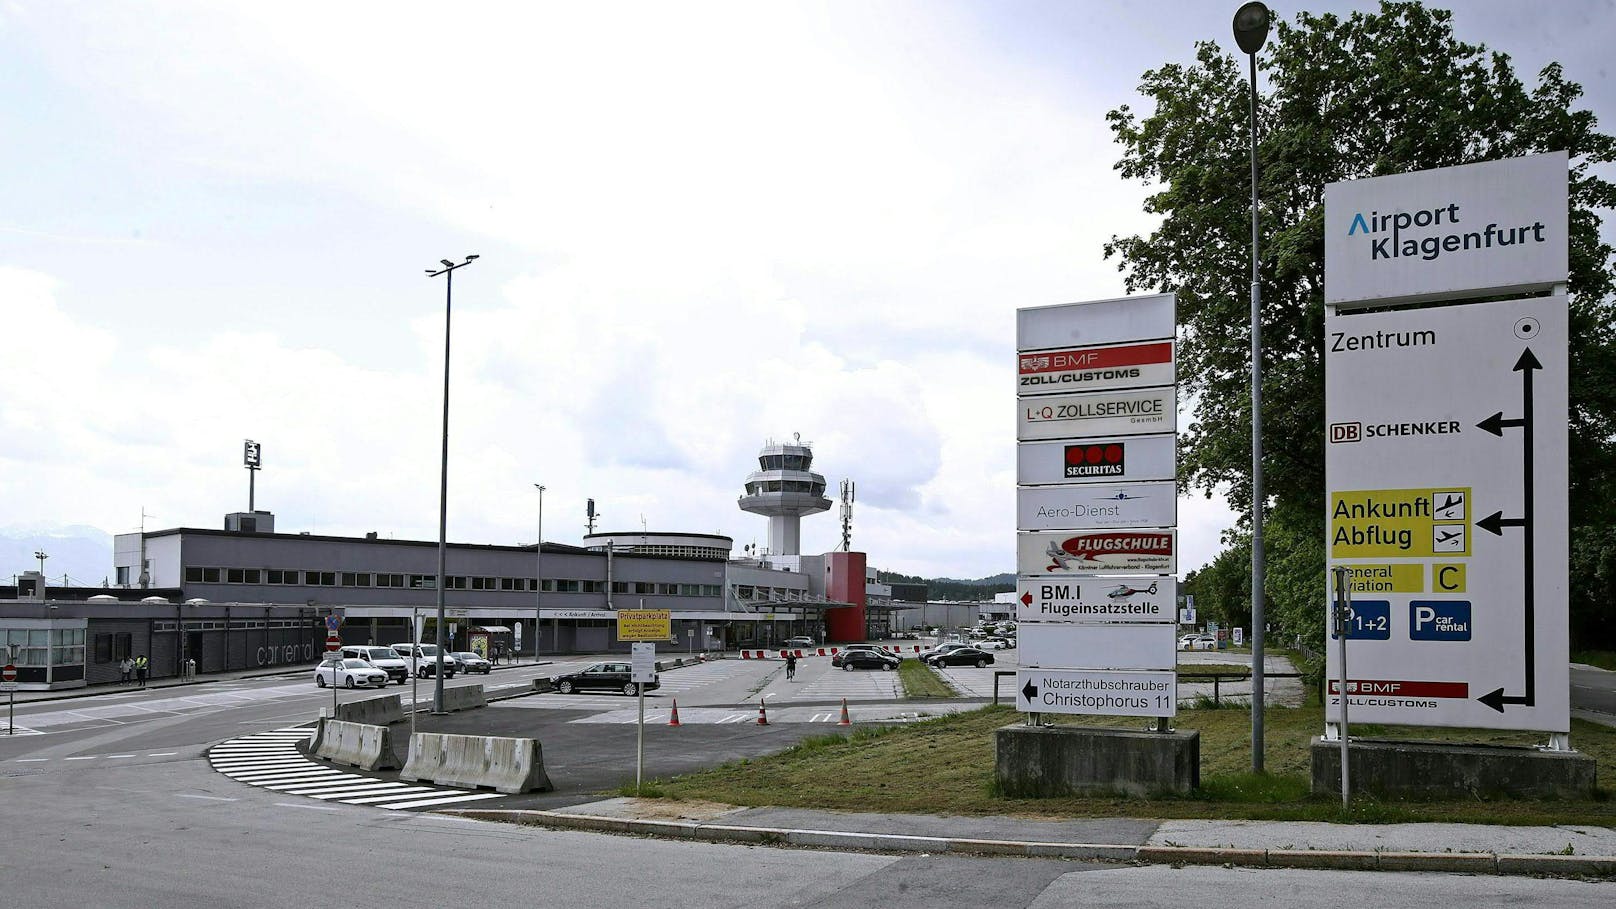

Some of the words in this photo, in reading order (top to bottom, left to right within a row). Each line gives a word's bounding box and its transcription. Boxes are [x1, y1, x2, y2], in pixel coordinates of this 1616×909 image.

[1347, 203, 1460, 242] Airport
[1371, 221, 1545, 261] Klagenfurt
[1331, 329, 1436, 352] Zentrum
[1053, 352, 1099, 368] BMF
[1020, 368, 1140, 386] ZOLL/CUSTOMS
[1057, 399, 1163, 419] ZOLLSERVICE
[1334, 425, 1359, 441] DB
[1366, 420, 1461, 438] SCHENKER
[1066, 464, 1122, 476] SECURITAS
[1036, 503, 1120, 518] Aero-Dienst
[1332, 496, 1431, 520] Ankunft
[1077, 537, 1169, 551] FLUGSCHULE
[1332, 524, 1413, 550] Abflug
[1335, 565, 1393, 578] eneral
[1439, 566, 1459, 590] C
[1041, 585, 1081, 600] BM.I
[620, 612, 668, 621] Privatparkplatz
[1041, 601, 1160, 616] Flugeinsatzstelle
[1414, 606, 1435, 631] P
[1435, 616, 1453, 625] car
[1435, 622, 1467, 632] rental
[1043, 677, 1169, 692] Notarzthubschrauber
[1360, 682, 1401, 693] BMF
[1043, 692, 1149, 710] Christophorus
[1154, 695, 1170, 709] 11
